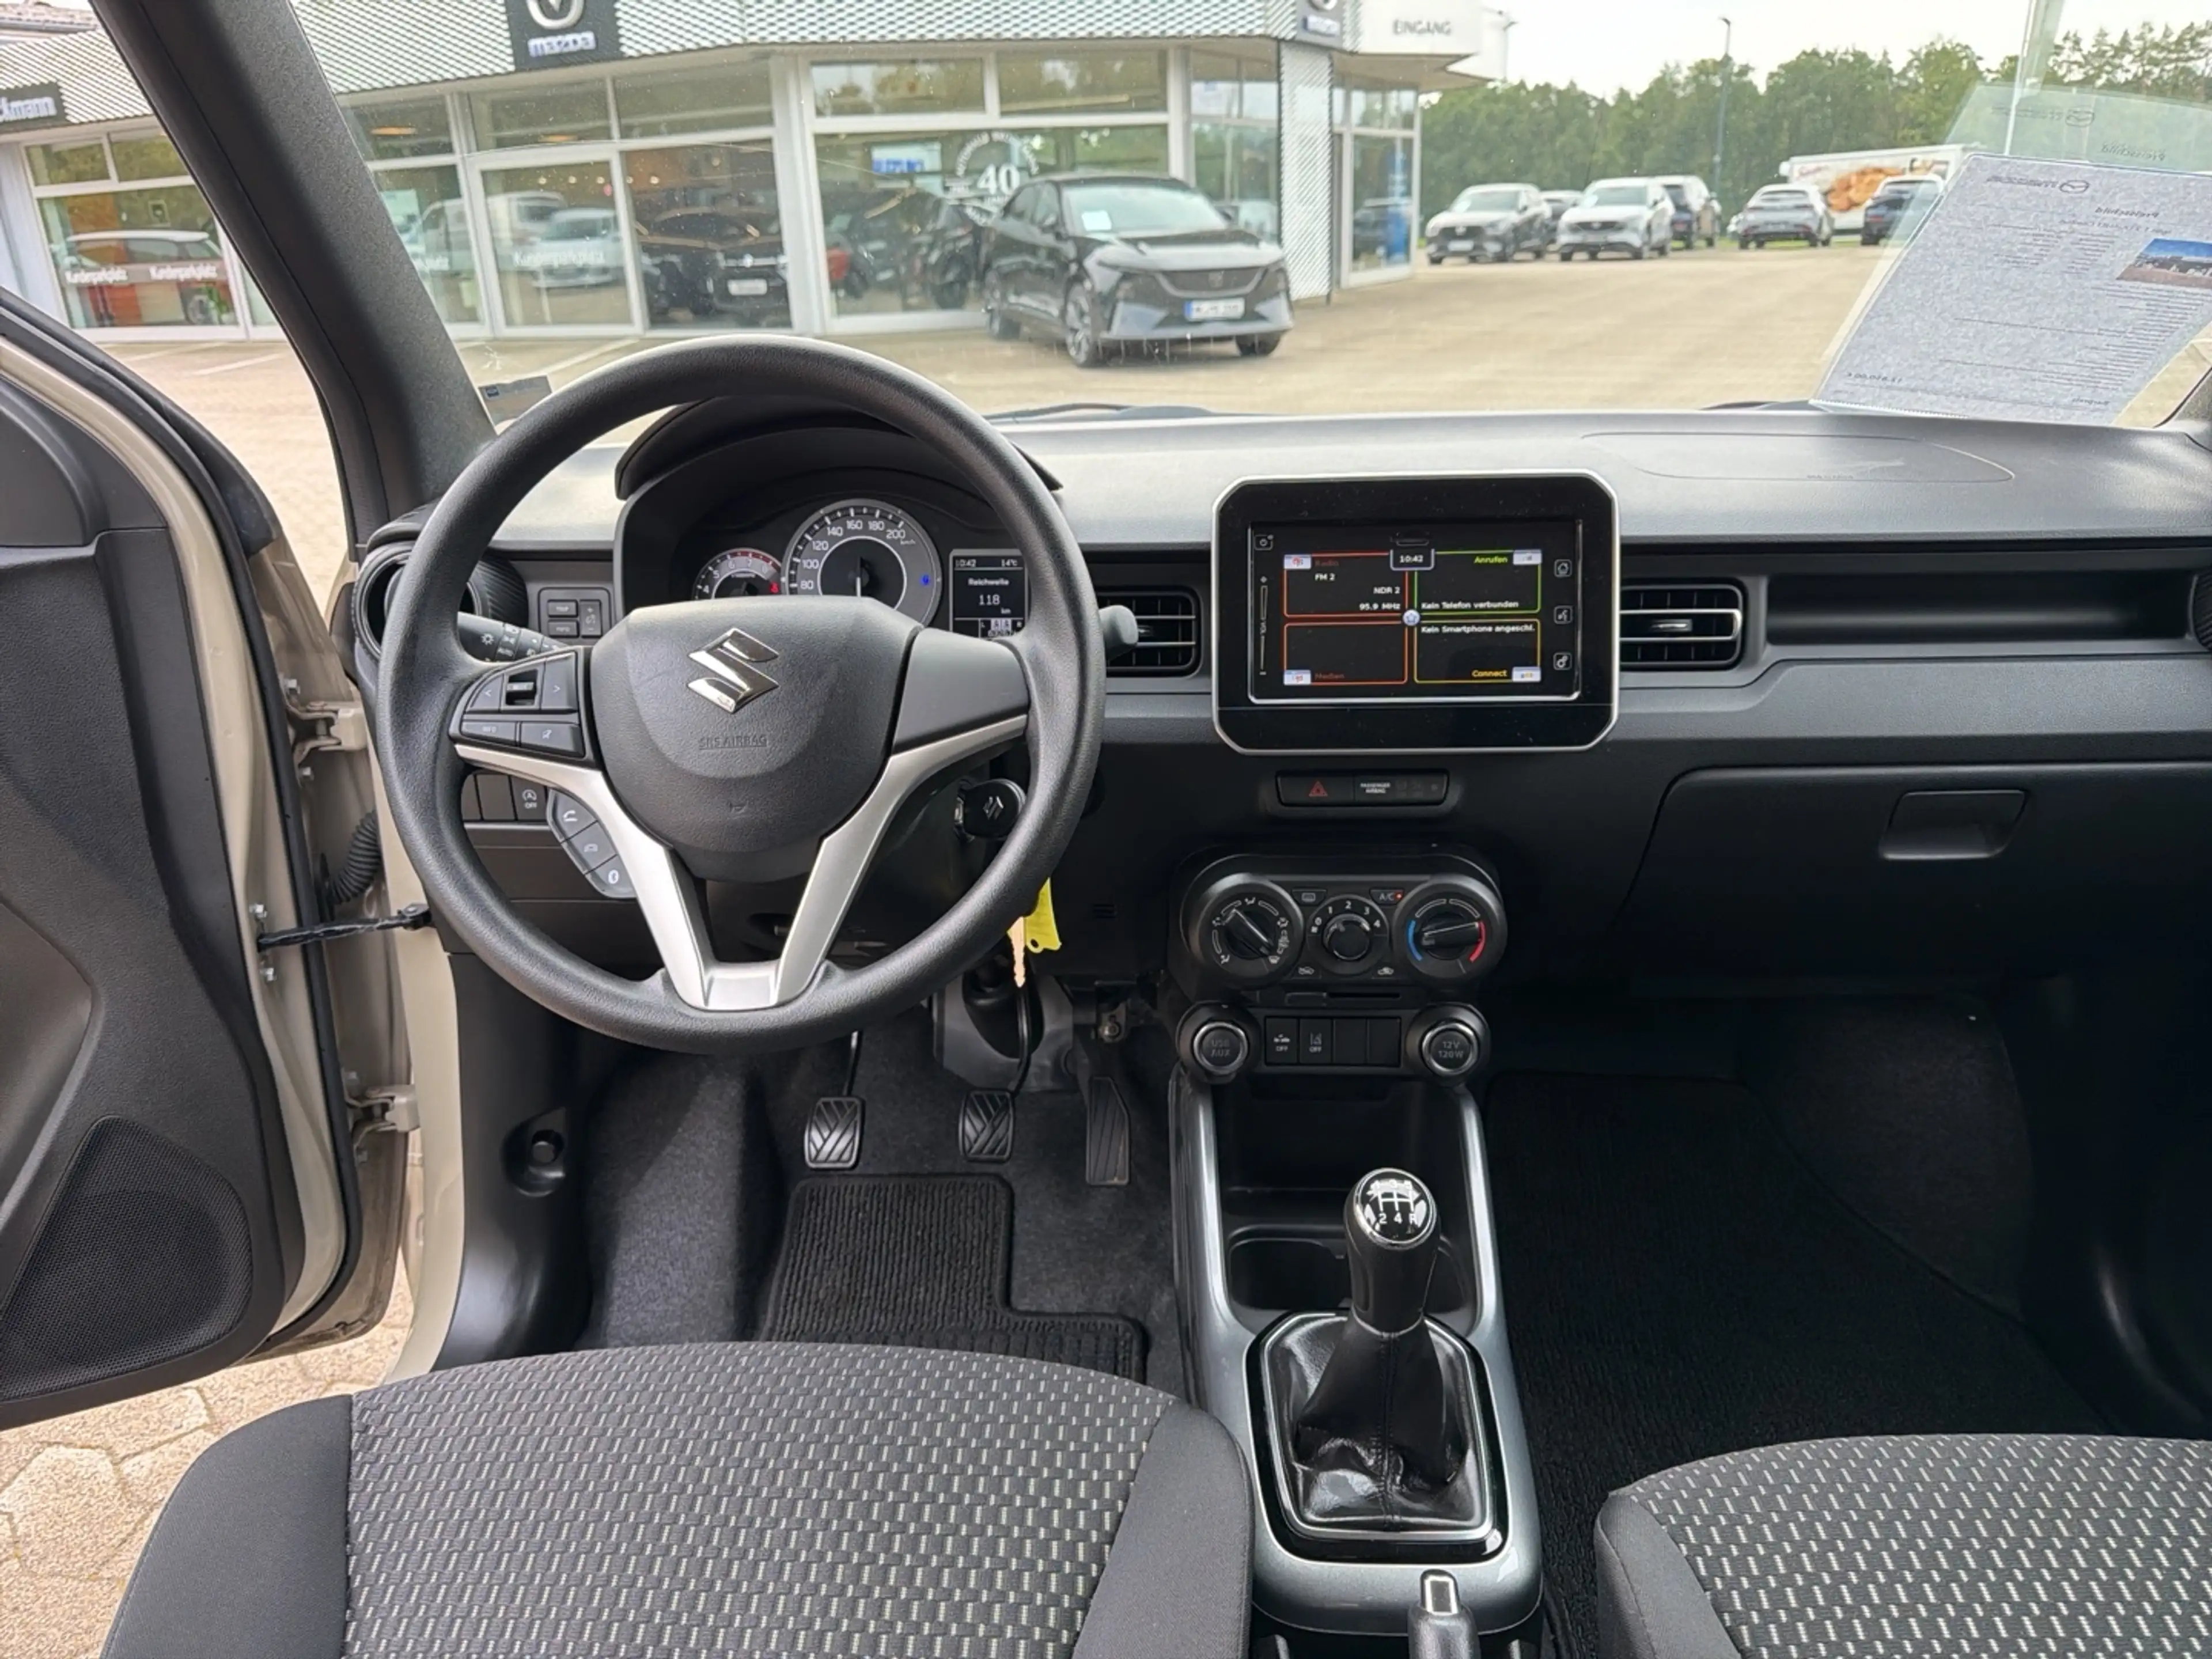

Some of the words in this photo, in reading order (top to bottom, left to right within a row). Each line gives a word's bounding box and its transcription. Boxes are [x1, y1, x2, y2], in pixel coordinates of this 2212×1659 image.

[1392, 18, 1452, 35] EINGANG
[977, 164, 1020, 195] 40
[846, 520, 863, 530] 160
[868, 521, 884, 531] 180
[827, 527, 843, 537] 140
[886, 529, 906, 540] 200
[812, 540, 829, 551] 120
[802, 559, 819, 569] 100
[1399, 555, 1423, 563] 10:42
[1474, 556, 1508, 564] Anrufen
[713, 570, 719, 578] 5
[800, 580, 814, 590] 80
[968, 578, 1009, 586] Reichweite
[703, 585, 709, 594] 4
[979, 594, 1000, 605] 118
[1442, 624, 1493, 634] Smartphone
[1495, 624, 1535, 634] angeschl.
[1472, 669, 1508, 678] Connect
[724, 734, 768, 747] AIRBAG
[1379, 893, 1394, 901] A/C
[1328, 906, 1333, 914] 1
[1344, 900, 1351, 910] 2
[1364, 907, 1370, 915] 3
[1373, 919, 1381, 928] 4
[1442, 1040, 1460, 1048] 12V
[1438, 1050, 1463, 1058] 120W
[1378, 1213, 1387, 1225] 2
[1394, 1212, 1403, 1224] 4
